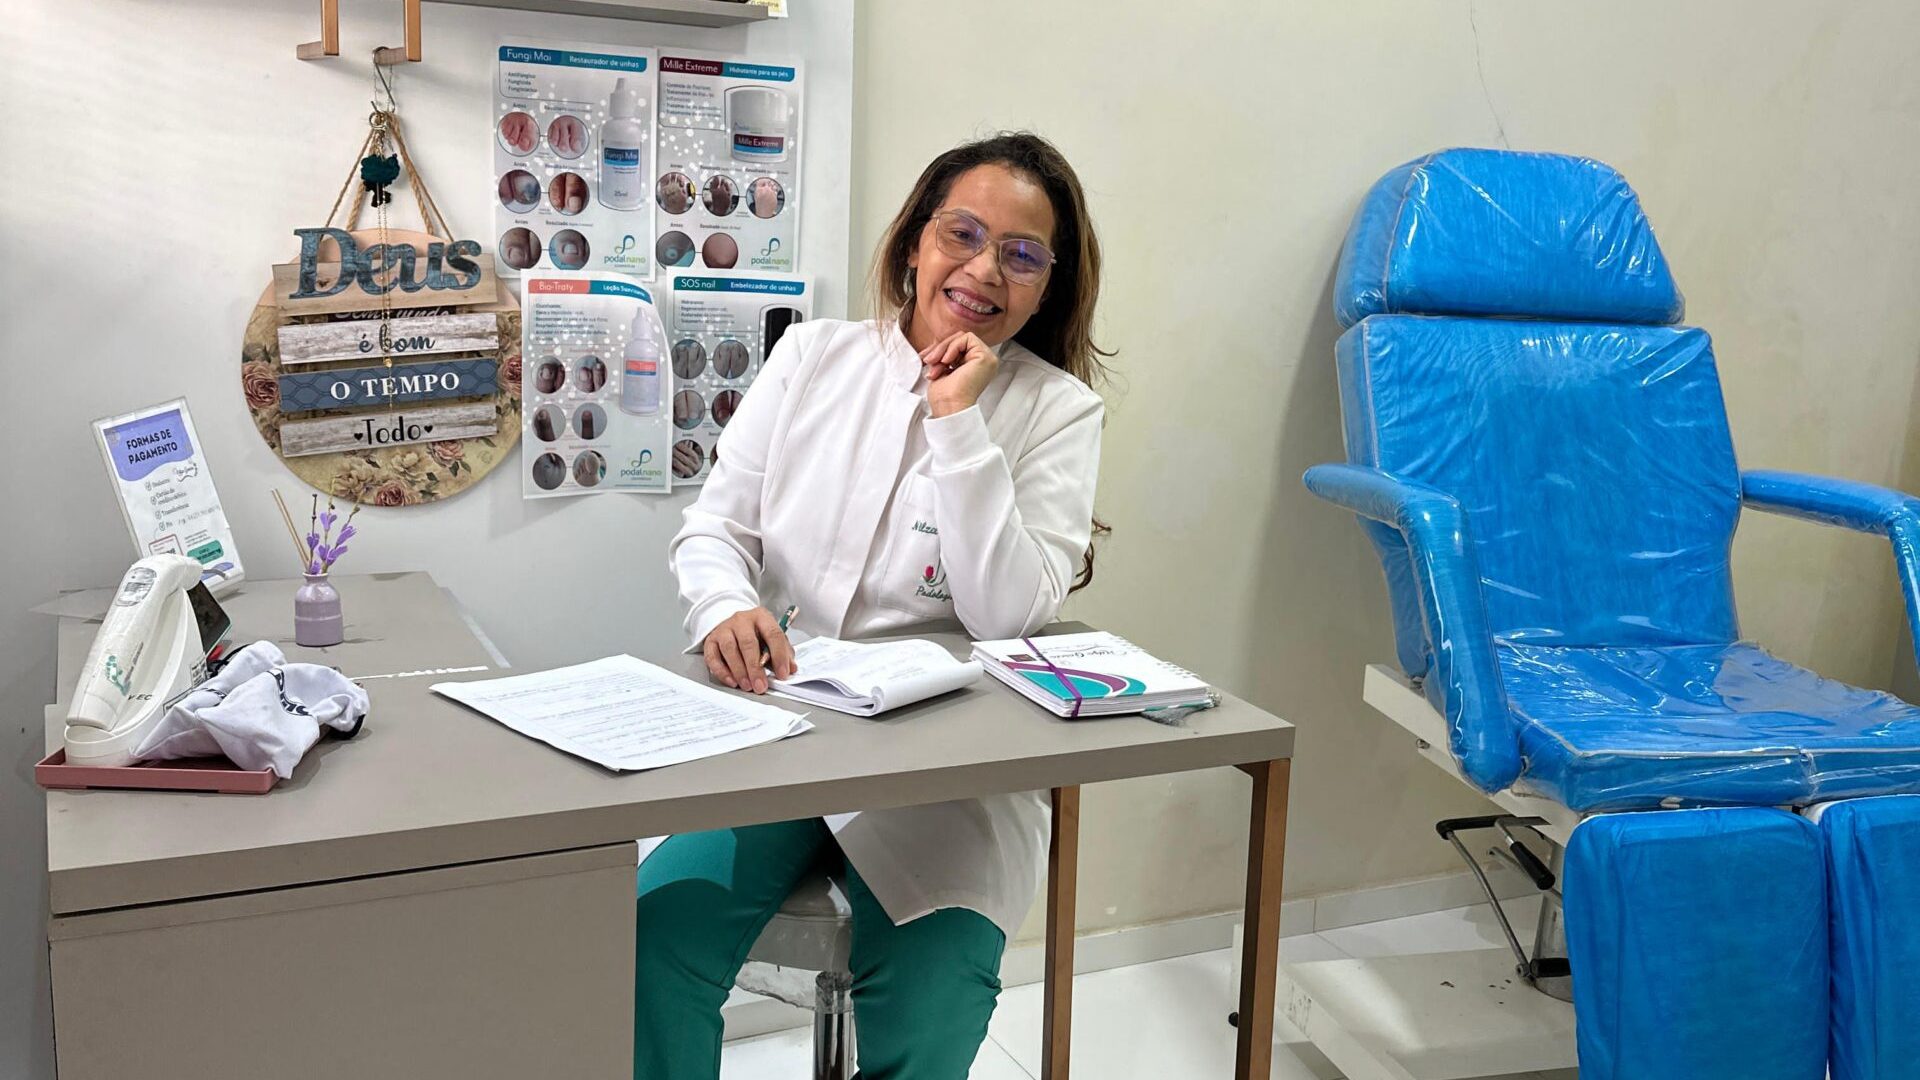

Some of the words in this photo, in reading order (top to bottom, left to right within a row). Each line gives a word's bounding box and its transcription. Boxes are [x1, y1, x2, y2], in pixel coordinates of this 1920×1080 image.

[507, 49, 532, 62] Fungi
[569, 55, 609, 66] Restaurador
[619, 60, 639, 68] unhas
[663, 59, 683, 70] Mille
[685, 61, 718, 73] Extreme
[288, 227, 482, 299] Deus
[681, 279, 700, 288] SOS
[701, 280, 716, 288] nail
[730, 281, 768, 290] Embelezador
[778, 284, 797, 292] unhas
[359, 333, 374, 353] é
[379, 324, 436, 353] bom
[330, 381, 350, 400] O
[361, 372, 460, 397] TEMPO
[126, 433, 160, 450] FORMAS
[160, 429, 172, 440] DE
[361, 416, 421, 445] Todo
[128, 441, 178, 465] PAGAMENTO
